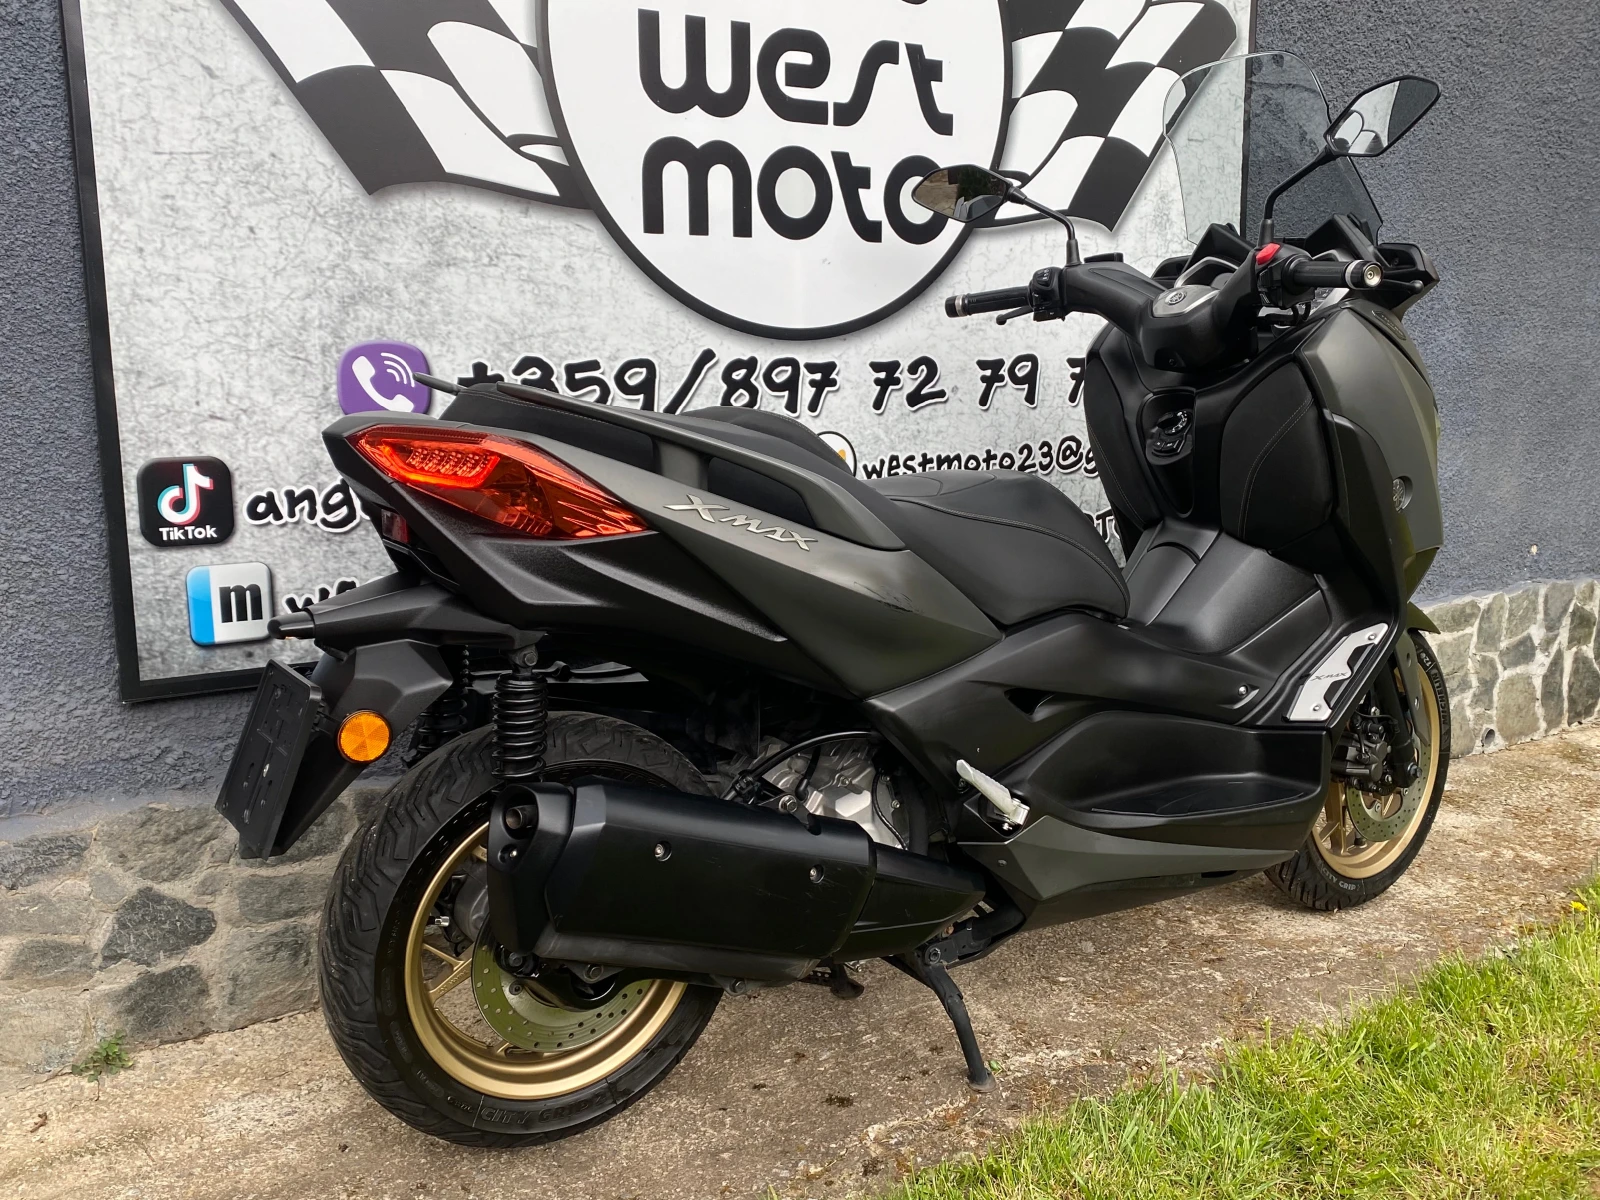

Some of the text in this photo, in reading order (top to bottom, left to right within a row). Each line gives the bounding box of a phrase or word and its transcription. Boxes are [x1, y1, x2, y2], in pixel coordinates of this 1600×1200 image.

[642, 136, 948, 246] moto
[869, 355, 947, 411] 72
[976, 353, 1039, 407] 79
[159, 525, 218, 541] TikTok
[218, 583, 264, 623] m
[1339, 881, 1356, 891] GRIP
